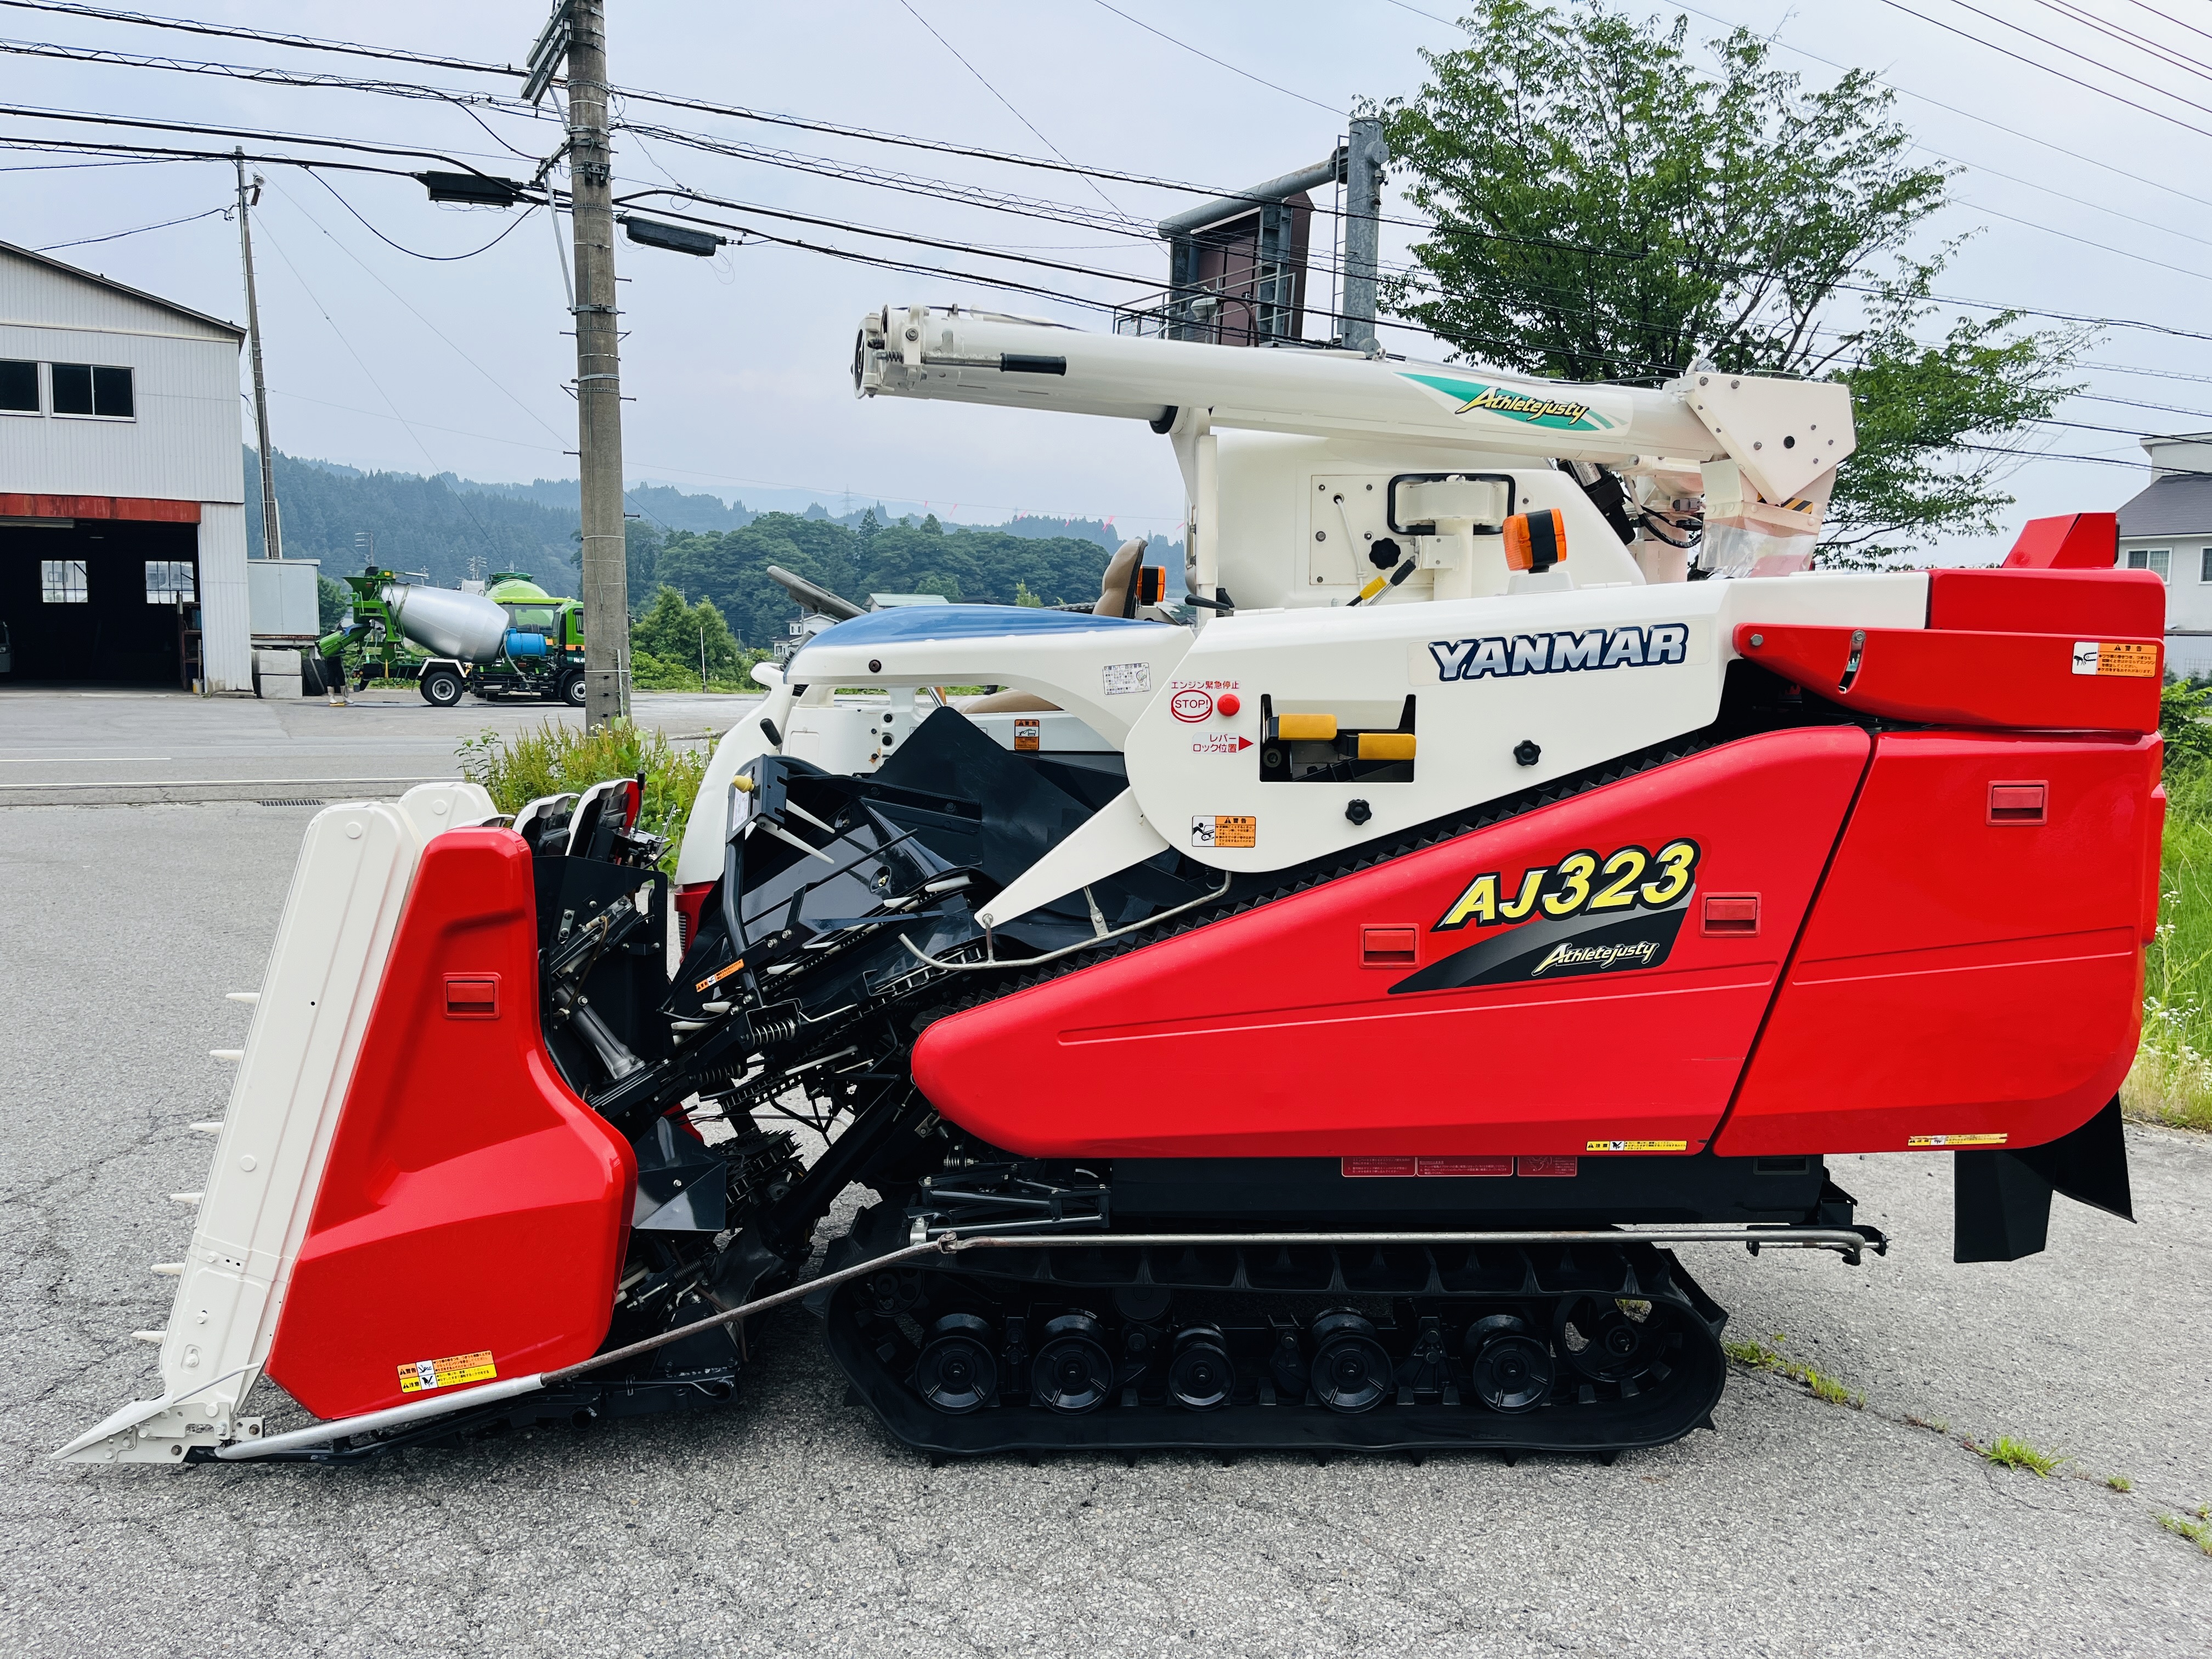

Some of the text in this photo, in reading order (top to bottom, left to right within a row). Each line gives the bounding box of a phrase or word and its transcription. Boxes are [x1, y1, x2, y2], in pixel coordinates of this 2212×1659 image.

[1455, 386, 1589, 425] Athletejusty
[1428, 623, 1689, 681] YANMAR
[1171, 681, 1239, 689] エンジン緊急停止
[1175, 699, 1209, 709] STOP!
[1193, 743, 1237, 753] ロック位置
[1210, 734, 1237, 742] レバー
[1431, 839, 1700, 931] AJ323
[1532, 941, 1659, 975] Athletejusty
